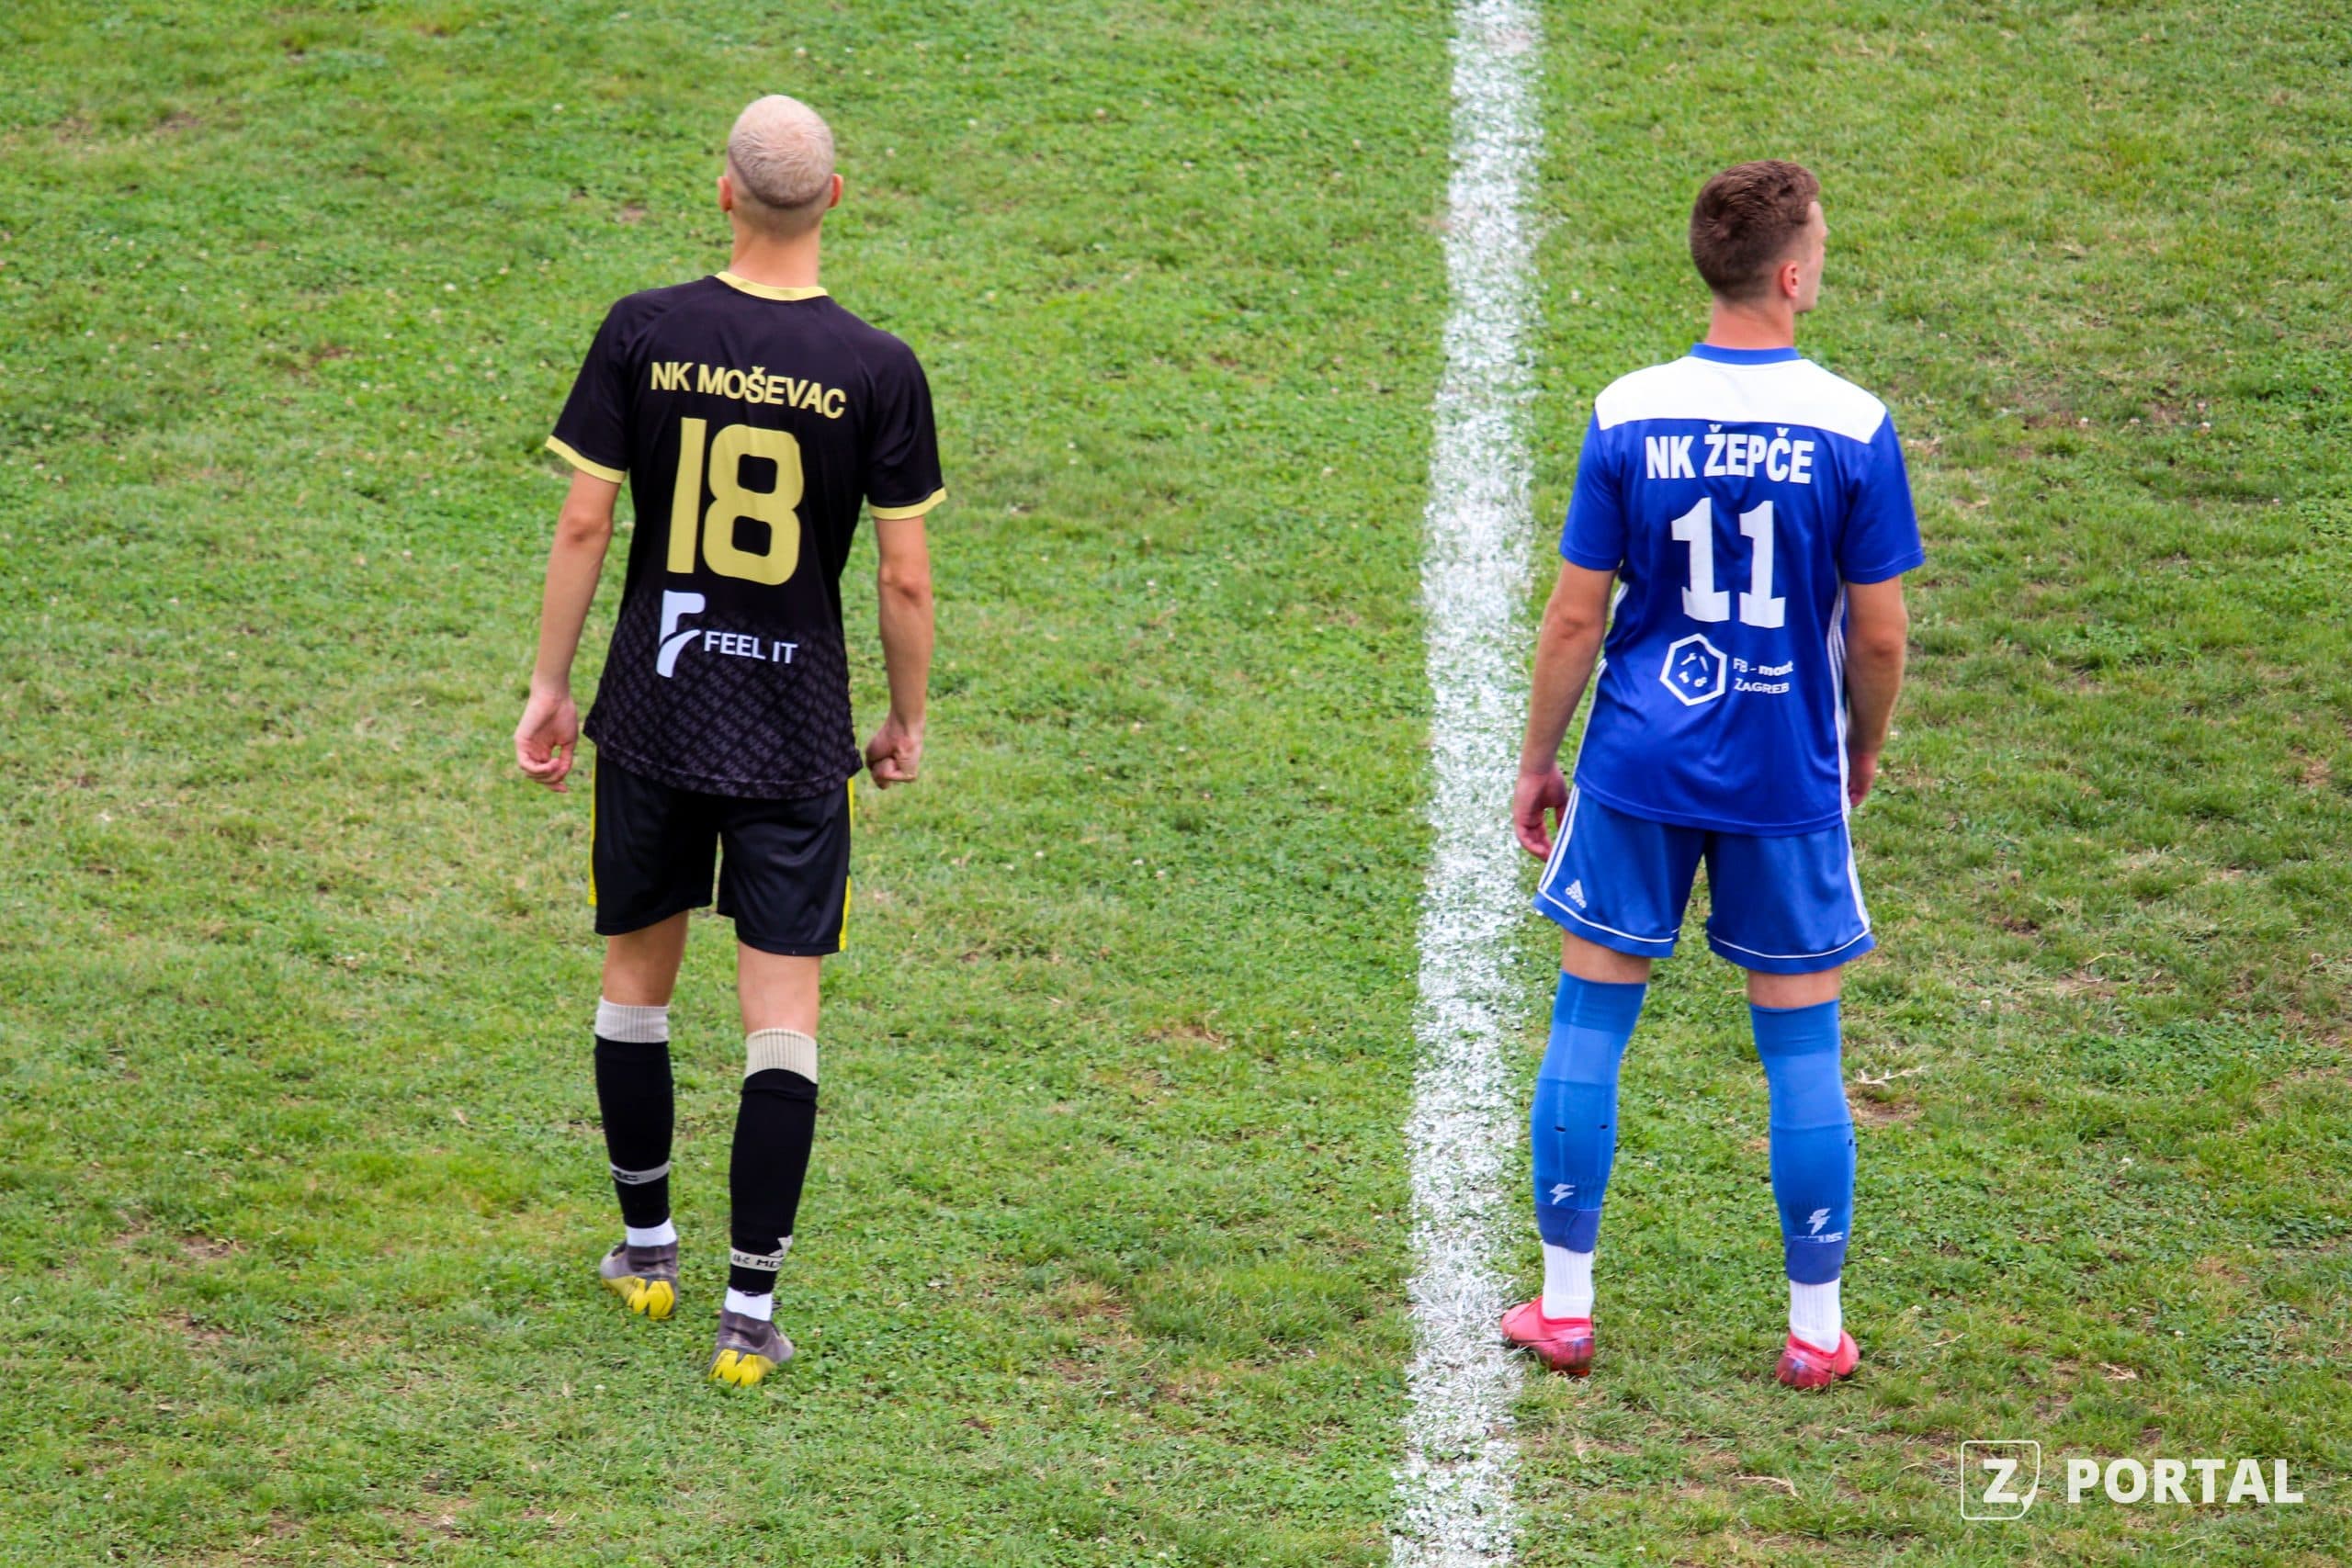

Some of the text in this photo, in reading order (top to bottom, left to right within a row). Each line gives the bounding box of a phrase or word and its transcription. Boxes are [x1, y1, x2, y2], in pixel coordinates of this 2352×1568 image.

[650, 362, 847, 419] NK MOŠEVAC
[1645, 423, 1815, 484] NK ŽEPČE
[666, 416, 805, 586] 18
[1670, 496, 1786, 628] 11
[704, 630, 799, 664] FEEL IT
[1734, 677, 1791, 694] ZAGREB
